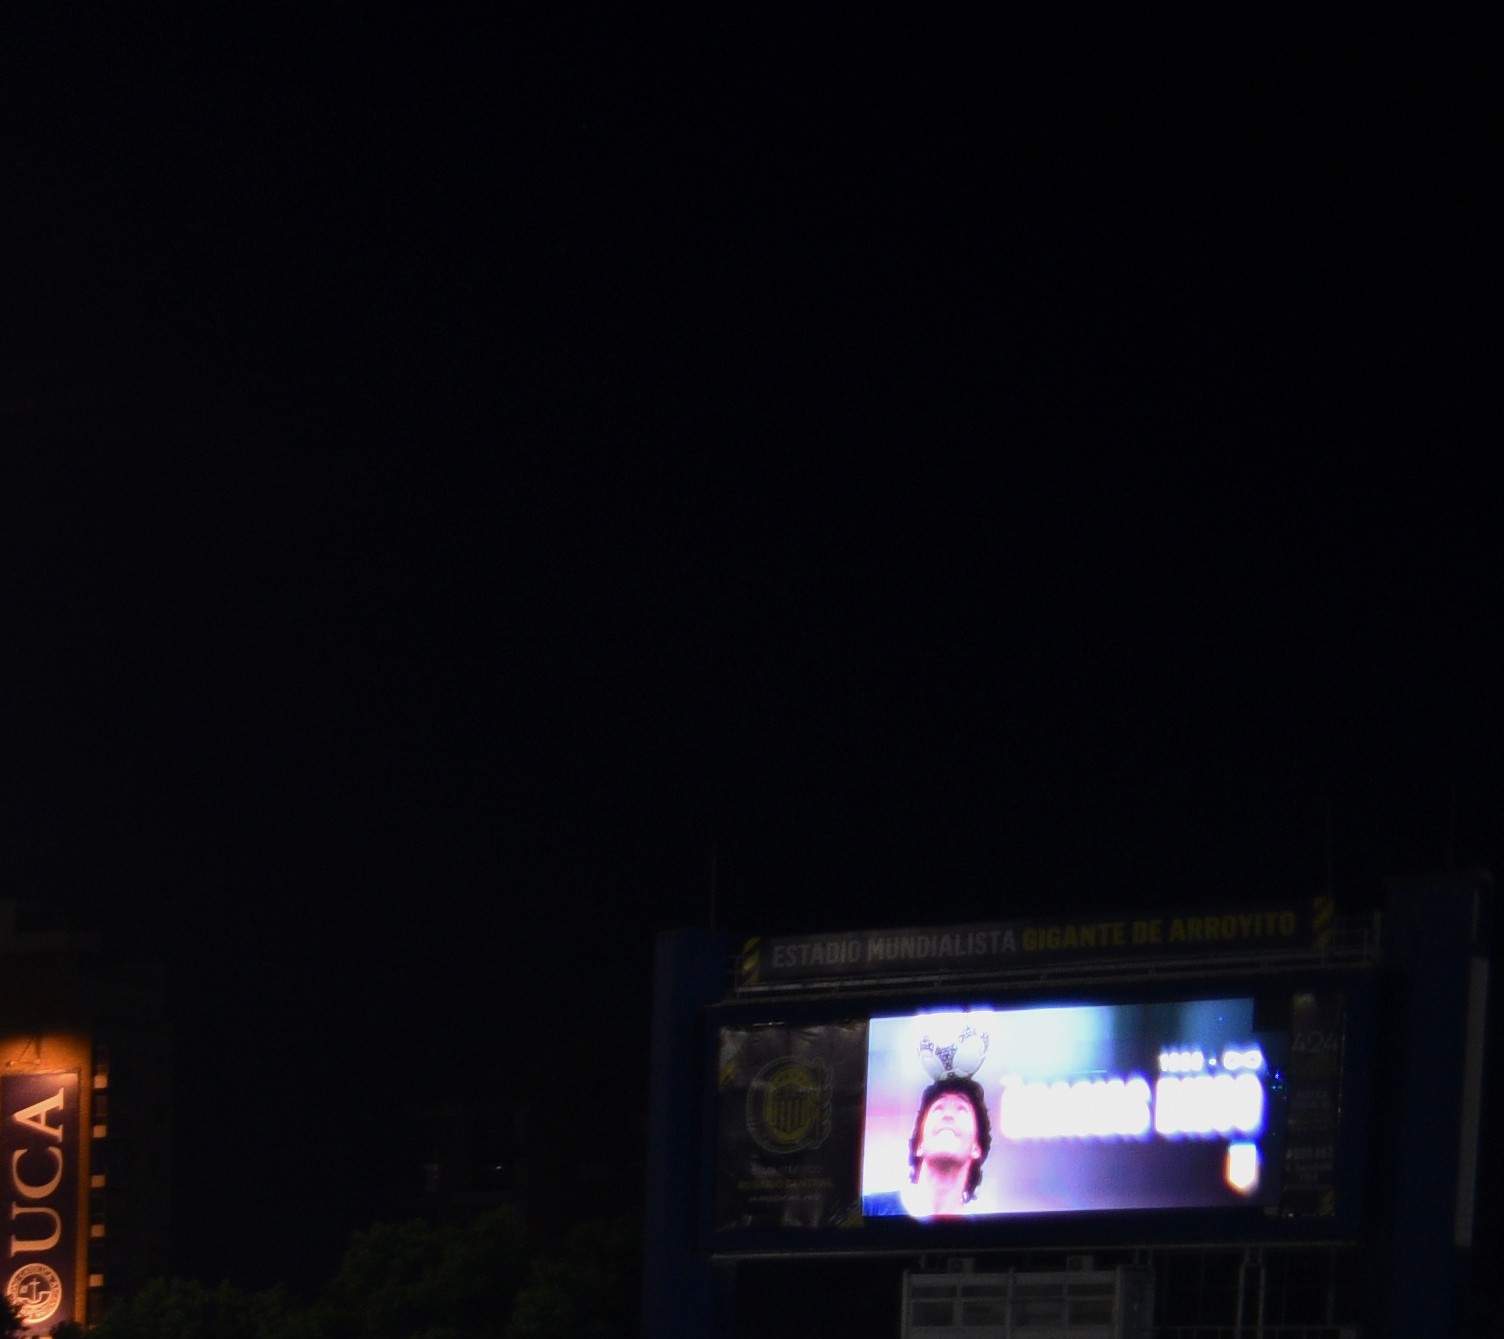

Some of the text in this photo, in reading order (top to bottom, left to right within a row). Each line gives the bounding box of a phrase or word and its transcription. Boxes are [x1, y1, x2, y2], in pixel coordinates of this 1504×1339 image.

[773, 911, 1295, 968] ESTADIO MUNDIALISTA GIGANTE DE ARROYITO
[11, 1088, 65, 1257] UCA
